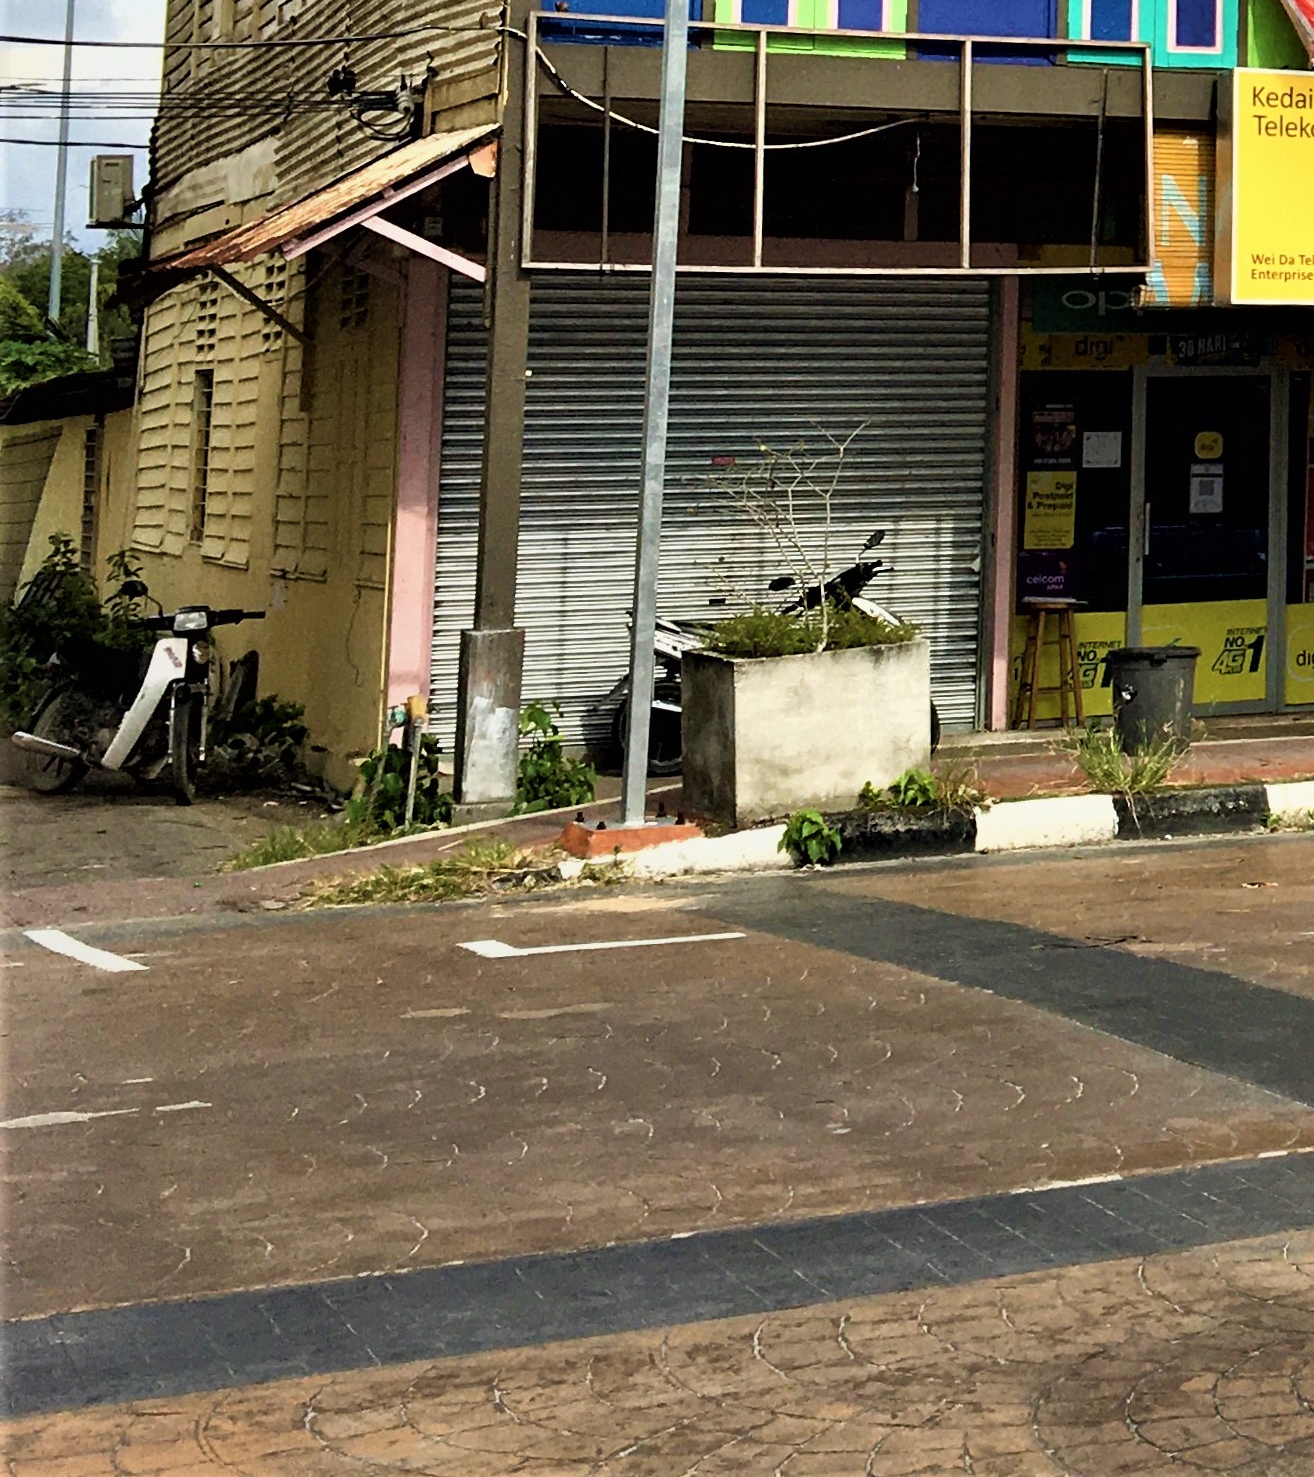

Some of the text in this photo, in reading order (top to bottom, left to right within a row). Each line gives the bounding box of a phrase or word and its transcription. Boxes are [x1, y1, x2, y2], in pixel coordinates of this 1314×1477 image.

[1252, 86, 1313, 109] Kedai
[1251, 254, 1276, 266] Wei
[1279, 254, 1295, 266] Da
[1251, 269, 1314, 282] Enterprise
[1075, 335, 1113, 361] digi
[1026, 574, 1065, 585] celcom
